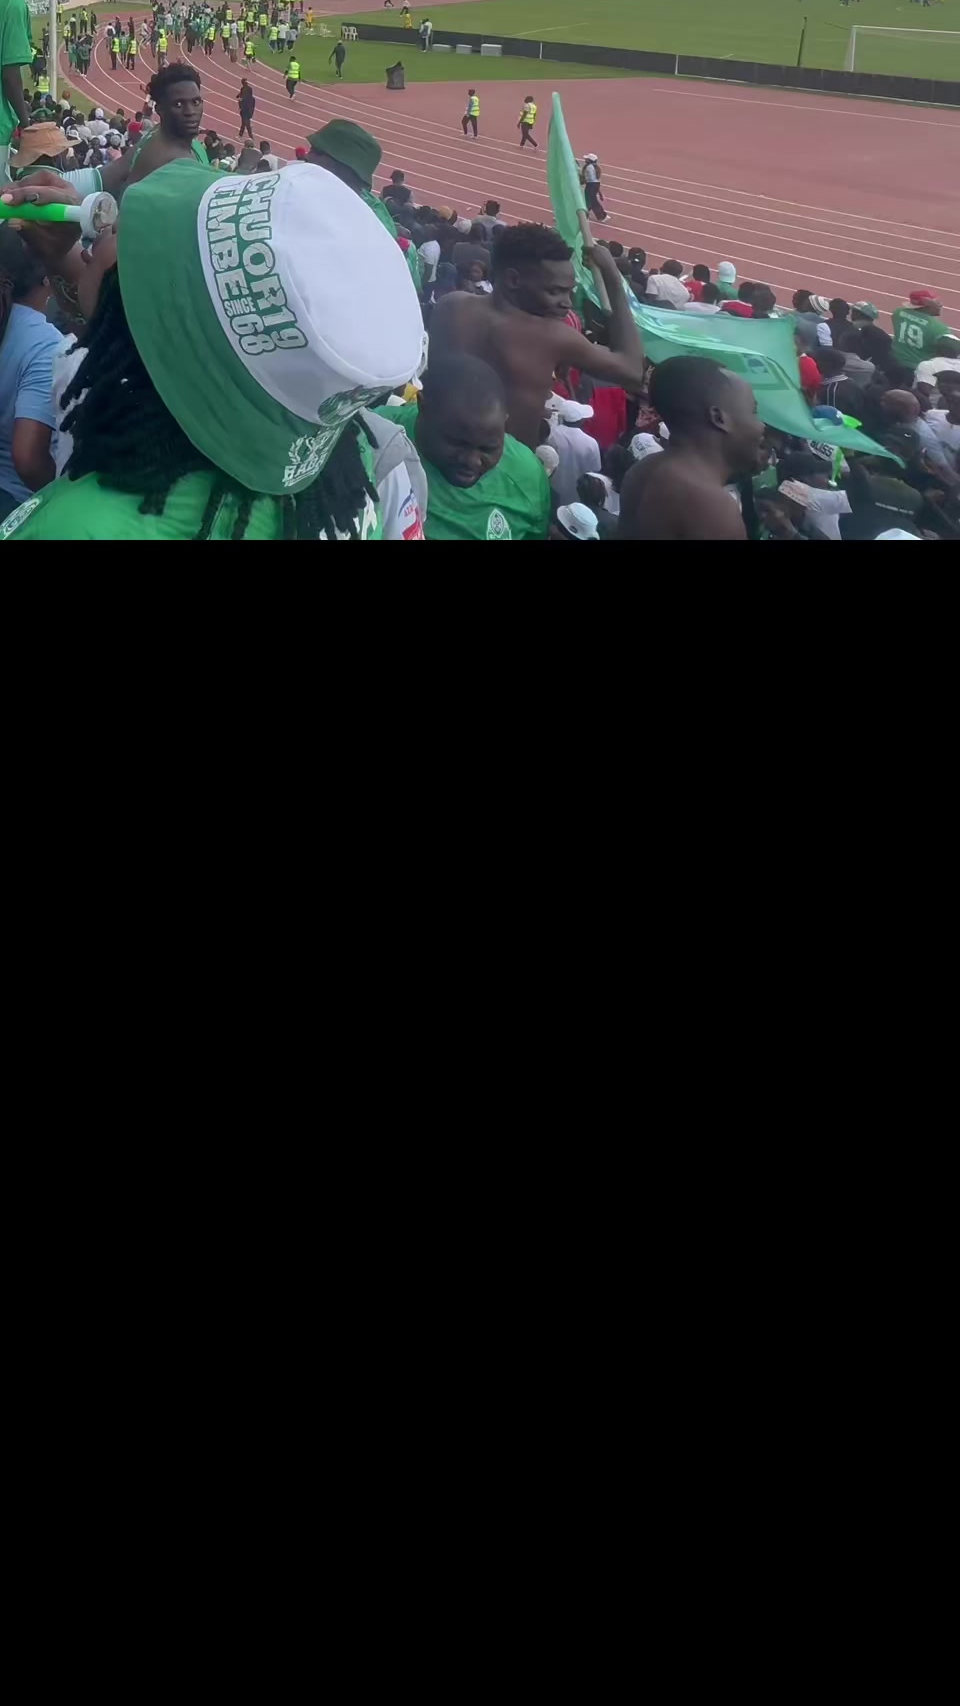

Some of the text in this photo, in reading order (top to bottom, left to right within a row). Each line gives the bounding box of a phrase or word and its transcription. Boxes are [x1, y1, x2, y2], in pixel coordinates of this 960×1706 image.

[224, 297, 256, 317] SINCE
[230, 313, 277, 356] 68
[898, 319, 924, 349] 19
